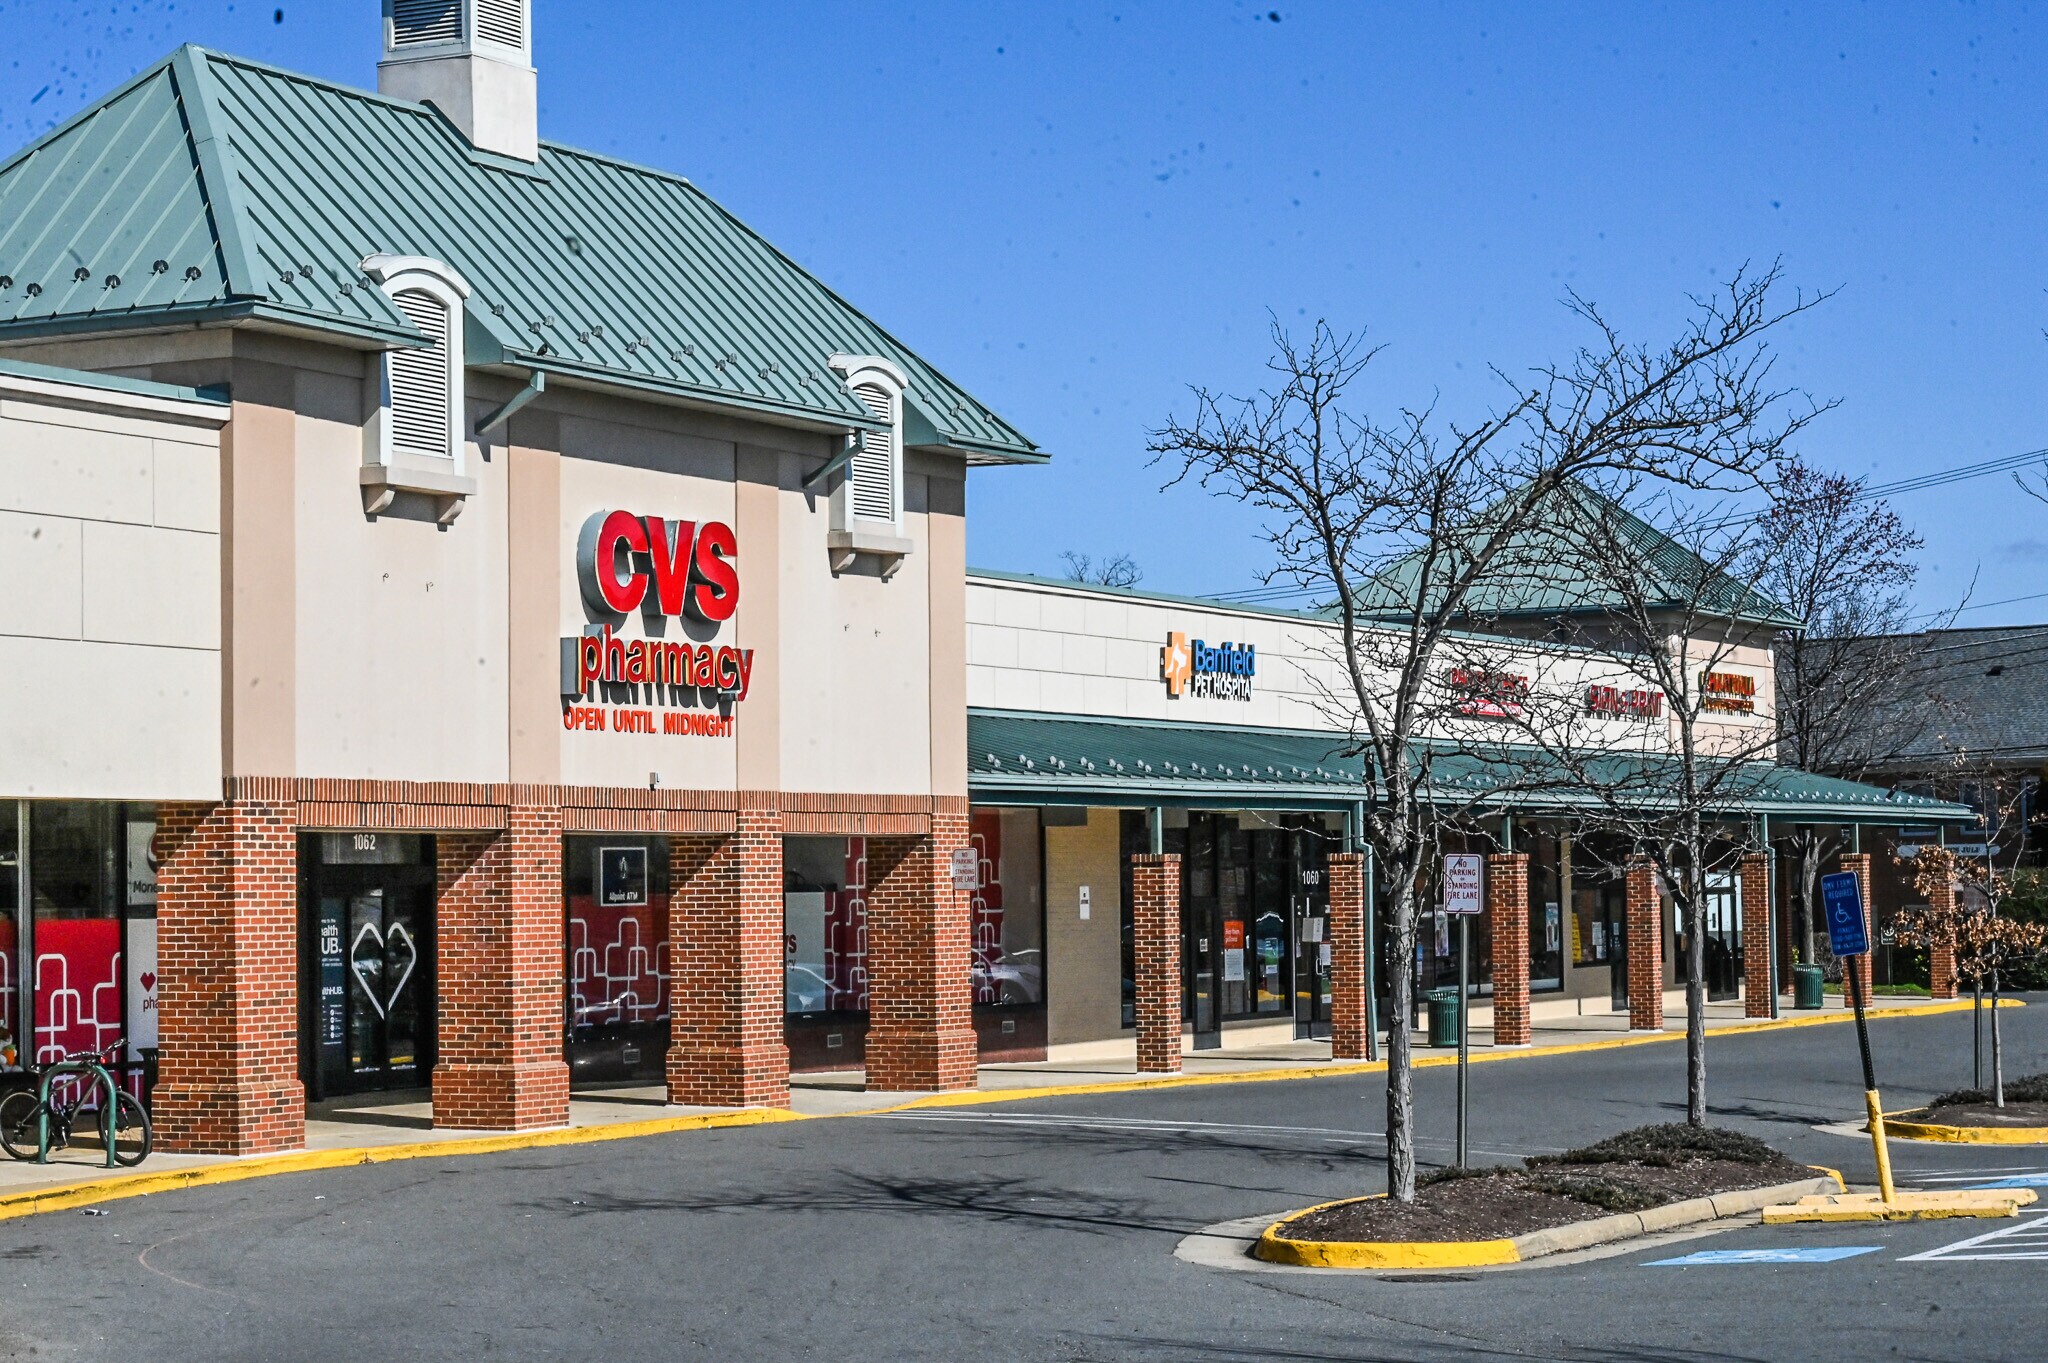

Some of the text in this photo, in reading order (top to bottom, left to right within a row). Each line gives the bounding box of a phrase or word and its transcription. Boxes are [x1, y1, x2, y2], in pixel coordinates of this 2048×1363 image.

[596, 509, 740, 622] CVS
[578, 623, 755, 702] pharmacy
[1194, 639, 1255, 677] Banfield
[564, 706, 734, 737] OPEN UNTIL MIDNIGHT
[354, 834, 376, 850] 1062
[1302, 871, 1319, 884] 1060
[1459, 860, 1467, 868] NO
